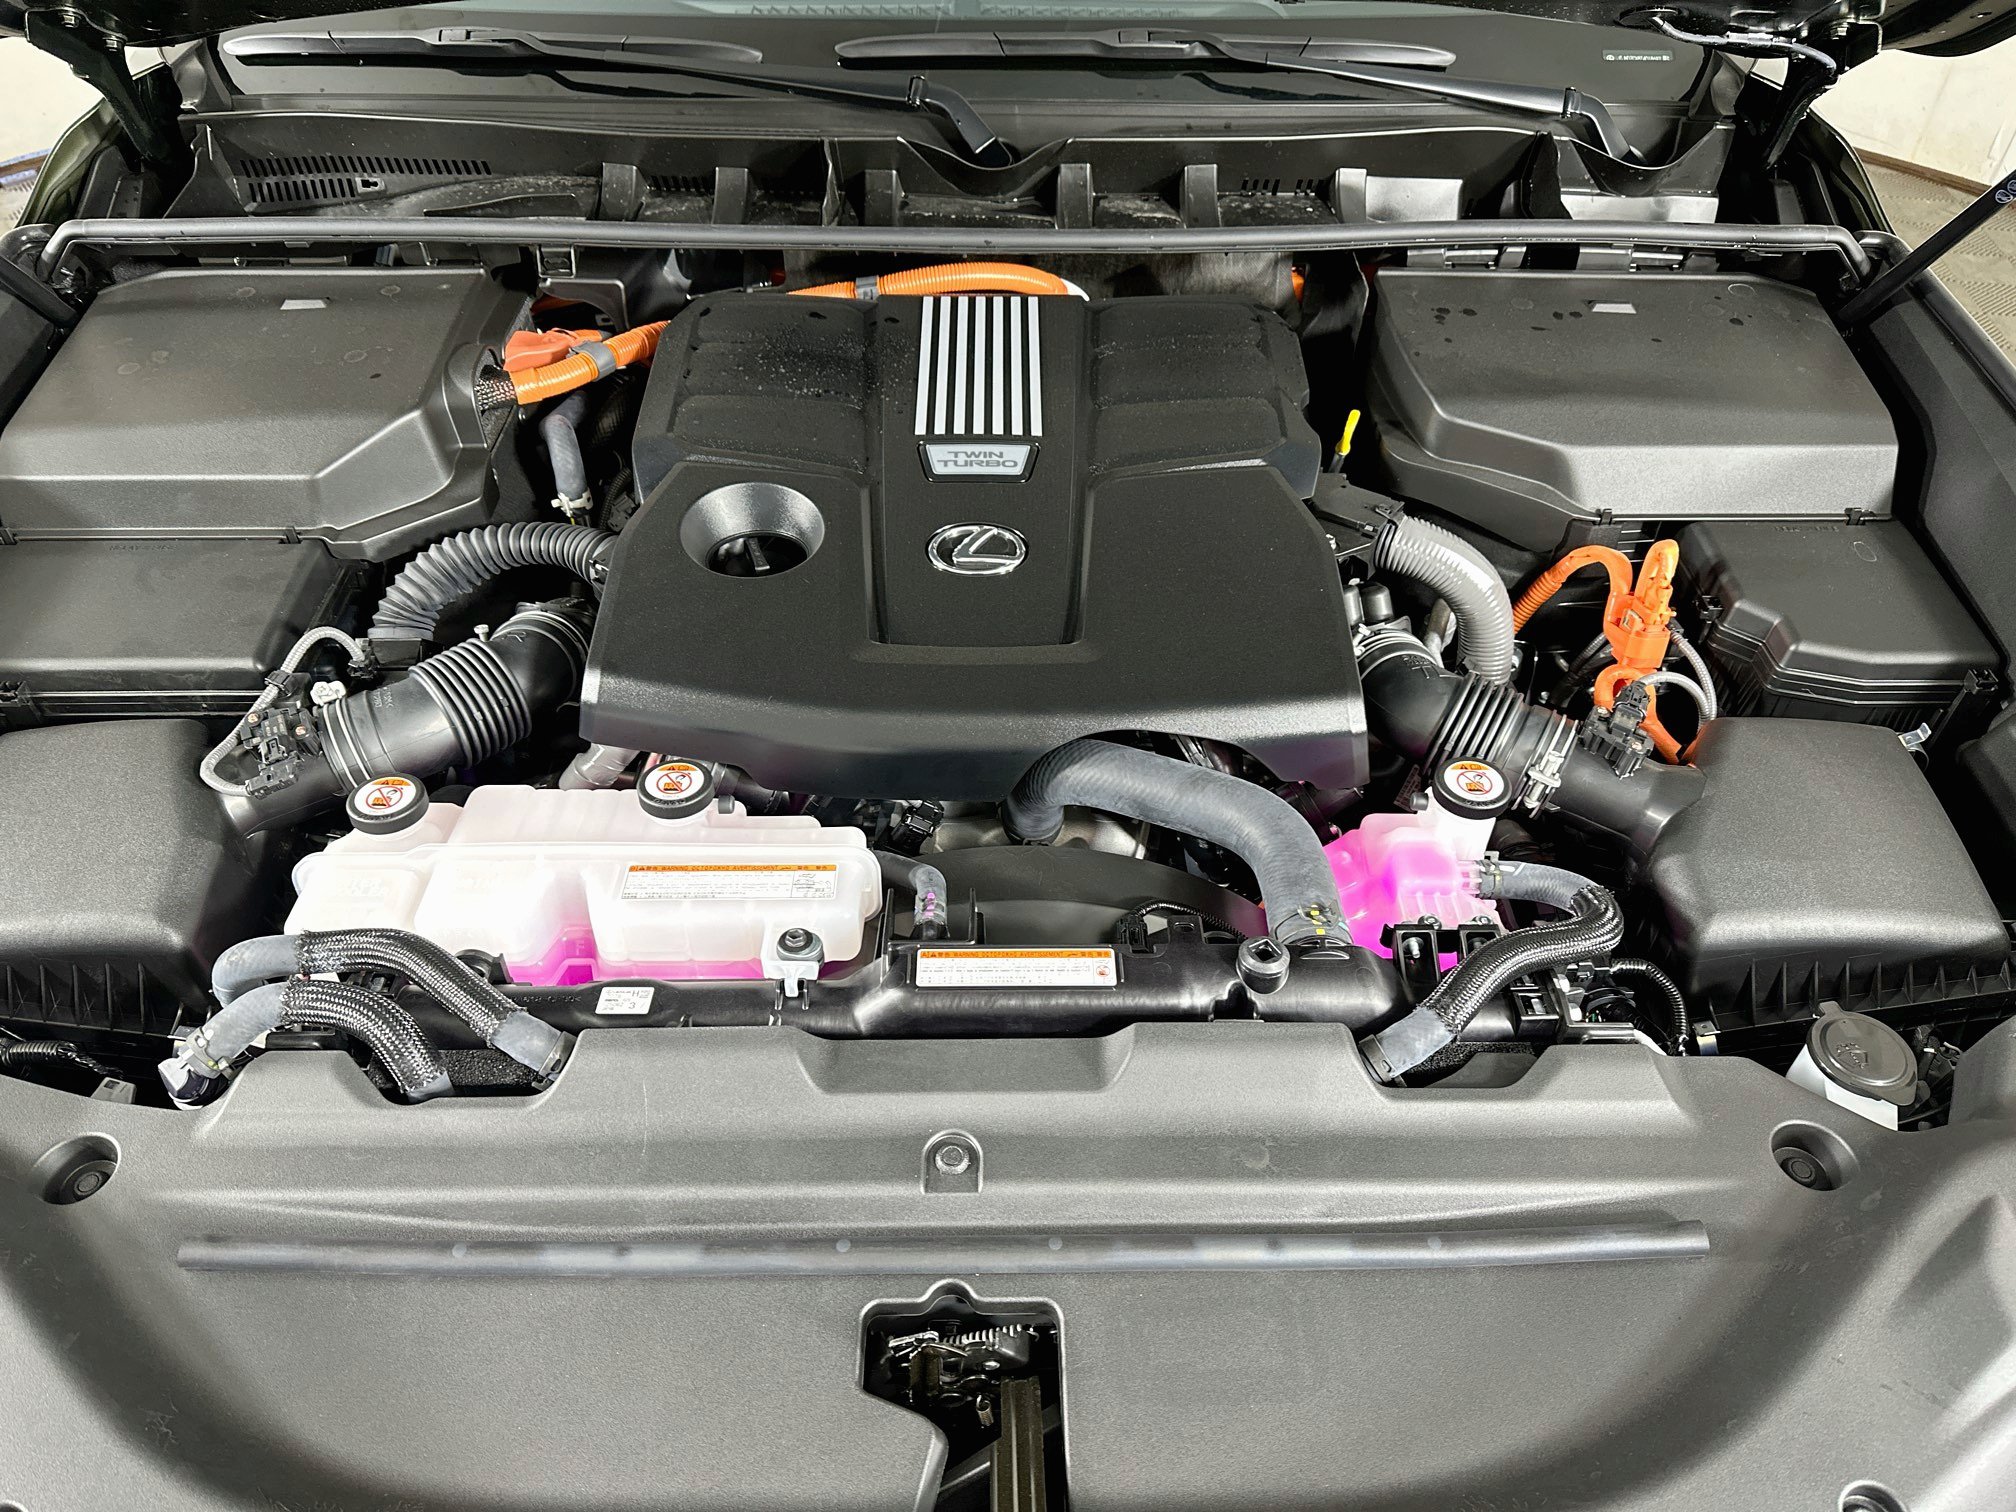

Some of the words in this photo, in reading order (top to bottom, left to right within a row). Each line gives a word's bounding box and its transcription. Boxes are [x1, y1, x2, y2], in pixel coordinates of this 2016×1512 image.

[947, 451, 1004, 459] TWIN
[937, 459, 1018, 468] TURBO
[628, 1001, 636, 1009] 3
